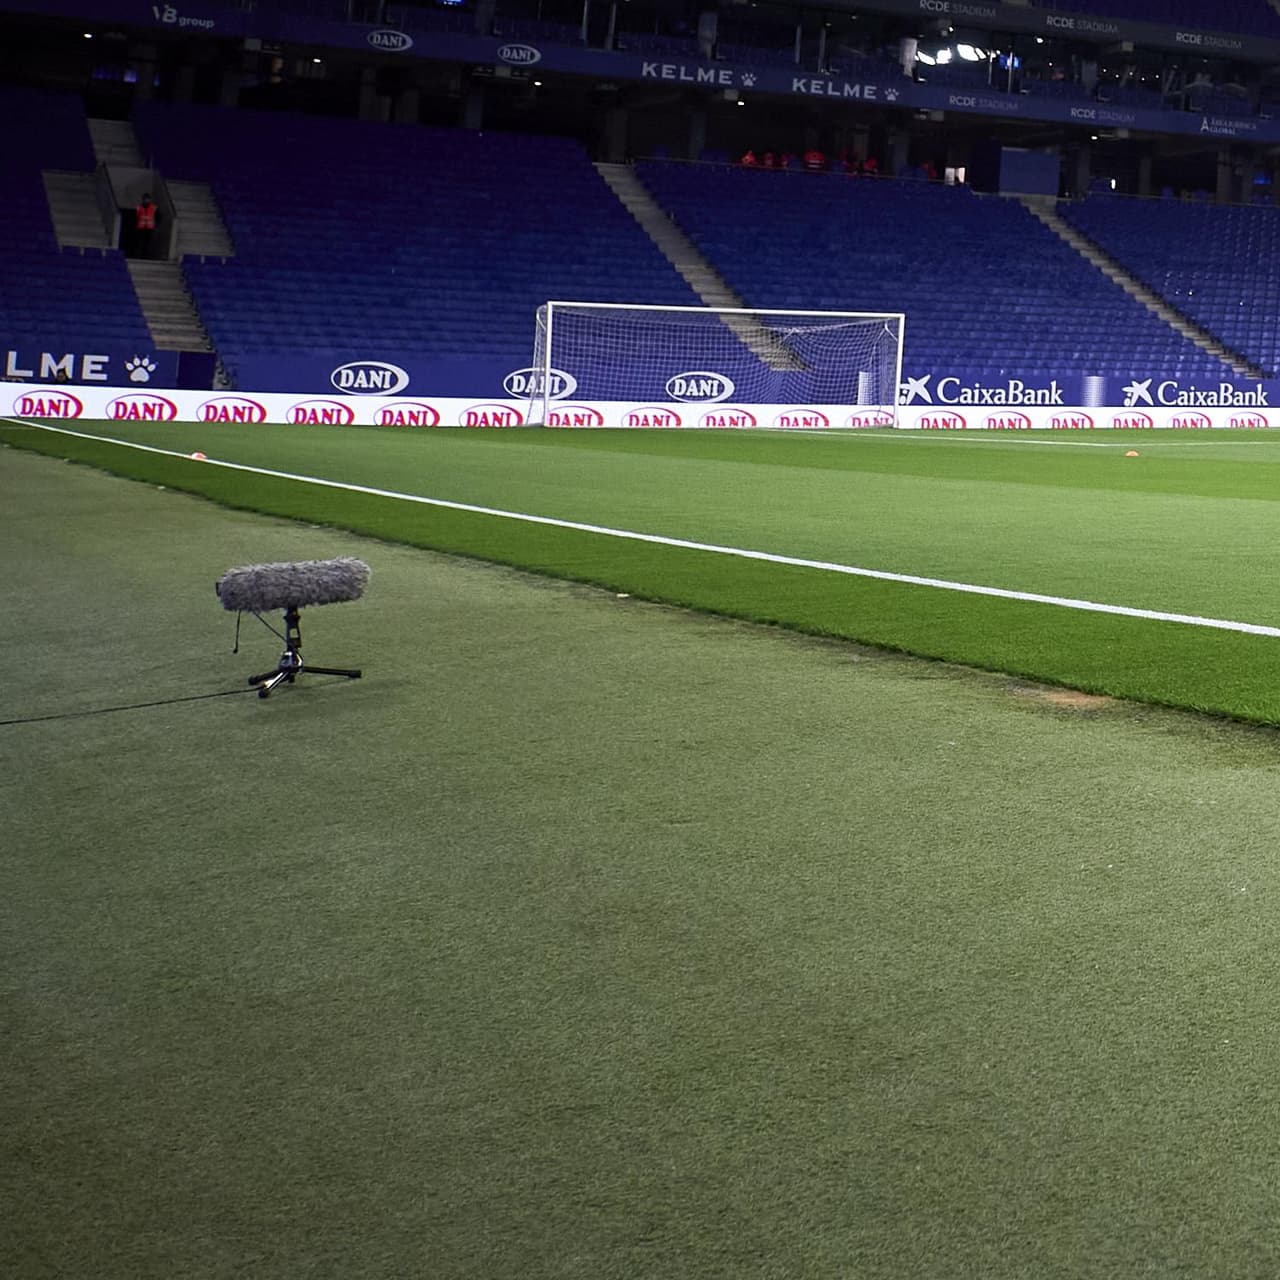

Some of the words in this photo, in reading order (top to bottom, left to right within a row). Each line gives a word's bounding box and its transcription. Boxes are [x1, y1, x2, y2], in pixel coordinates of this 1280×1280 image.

[920, 0, 950, 13] RCDE
[952, 3, 996, 18] STADIUM
[179, 16, 215, 30] group
[1047, 16, 1075, 30] RCDE
[373, 31, 404, 48] DANI
[1176, 32, 1202, 45] RCDE
[502, 48, 532, 62] DANI
[642, 62, 733, 85] KELME
[792, 77, 878, 101] KELME
[949, 94, 977, 108] RCDE
[1070, 107, 1096, 119] RCDE
[6, 350, 110, 381] LME
[340, 369, 392, 389] DANI
[673, 378, 720, 397] DANI
[937, 377, 1064, 405] CaixaBank
[1157, 381, 1268, 407] CaixaBank
[21, 397, 70, 417] DANI
[113, 400, 164, 420] DANI
[205, 404, 254, 423] DANI
[293, 407, 342, 424] DANI
[382, 409, 428, 426] DANI
[466, 411, 511, 427] DANI
[549, 412, 593, 426] DANI
[629, 413, 671, 426] DANI
[706, 415, 746, 427] DANI
[780, 416, 819, 427] DANI
[852, 417, 890, 427] DANI
[921, 417, 957, 428] DANI
[988, 417, 1022, 428] DANI
[1051, 418, 1084, 428] DANI
[1113, 418, 1145, 428] DANI
[1172, 418, 1204, 428] DANI
[1230, 418, 1261, 428] DANI
